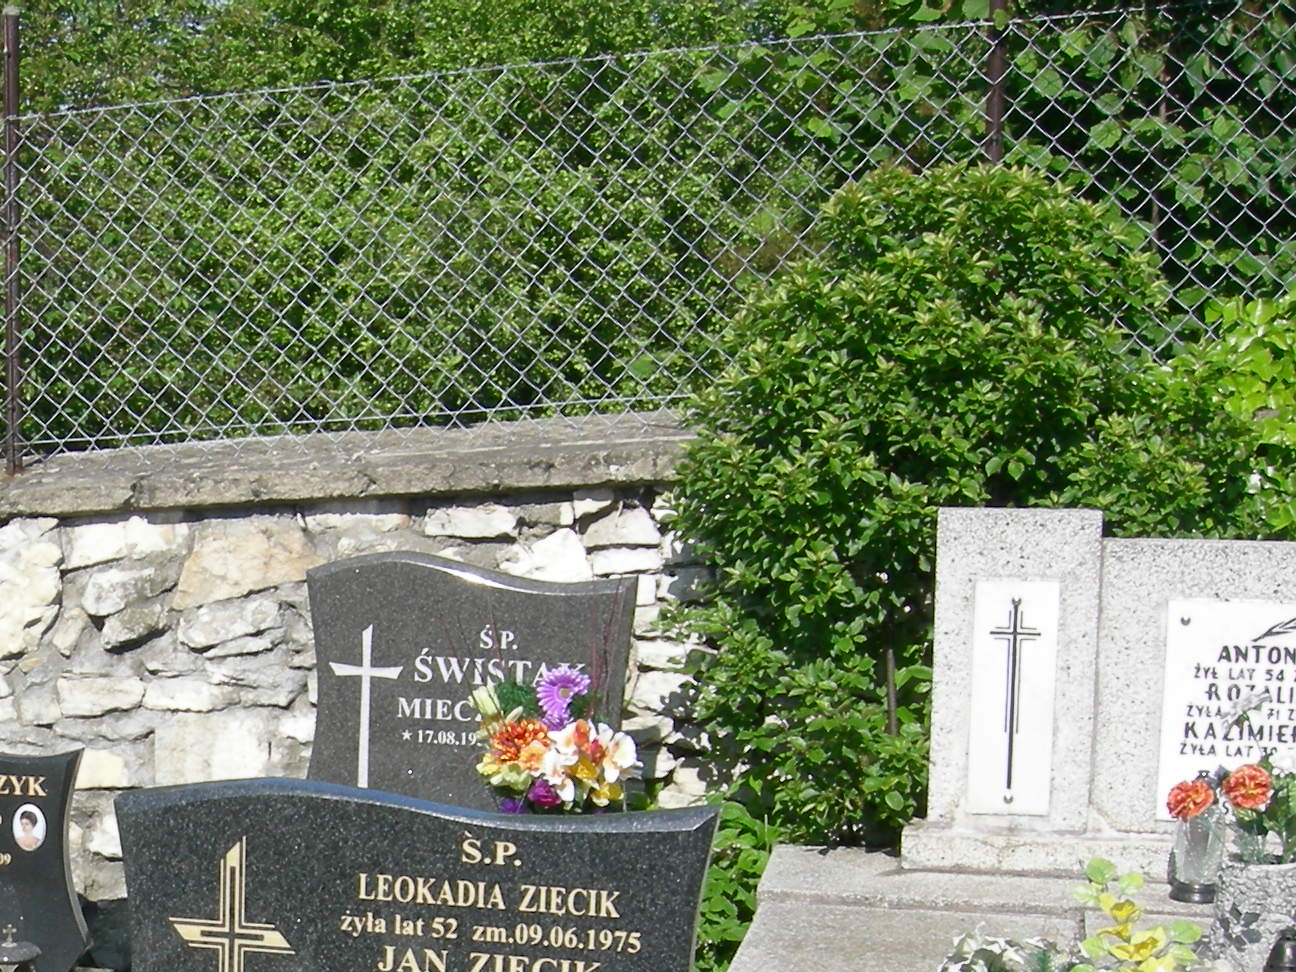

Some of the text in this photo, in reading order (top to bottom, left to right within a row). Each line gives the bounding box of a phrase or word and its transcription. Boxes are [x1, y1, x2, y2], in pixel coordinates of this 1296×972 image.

[1229, 669, 1256, 681] LAT
[1226, 745, 1254, 757] LAT
[359, 872, 621, 919] LEOKADIA ZIĘCIK
[340, 910, 642, 954] żyła lat 52 zm.09.06.1975
